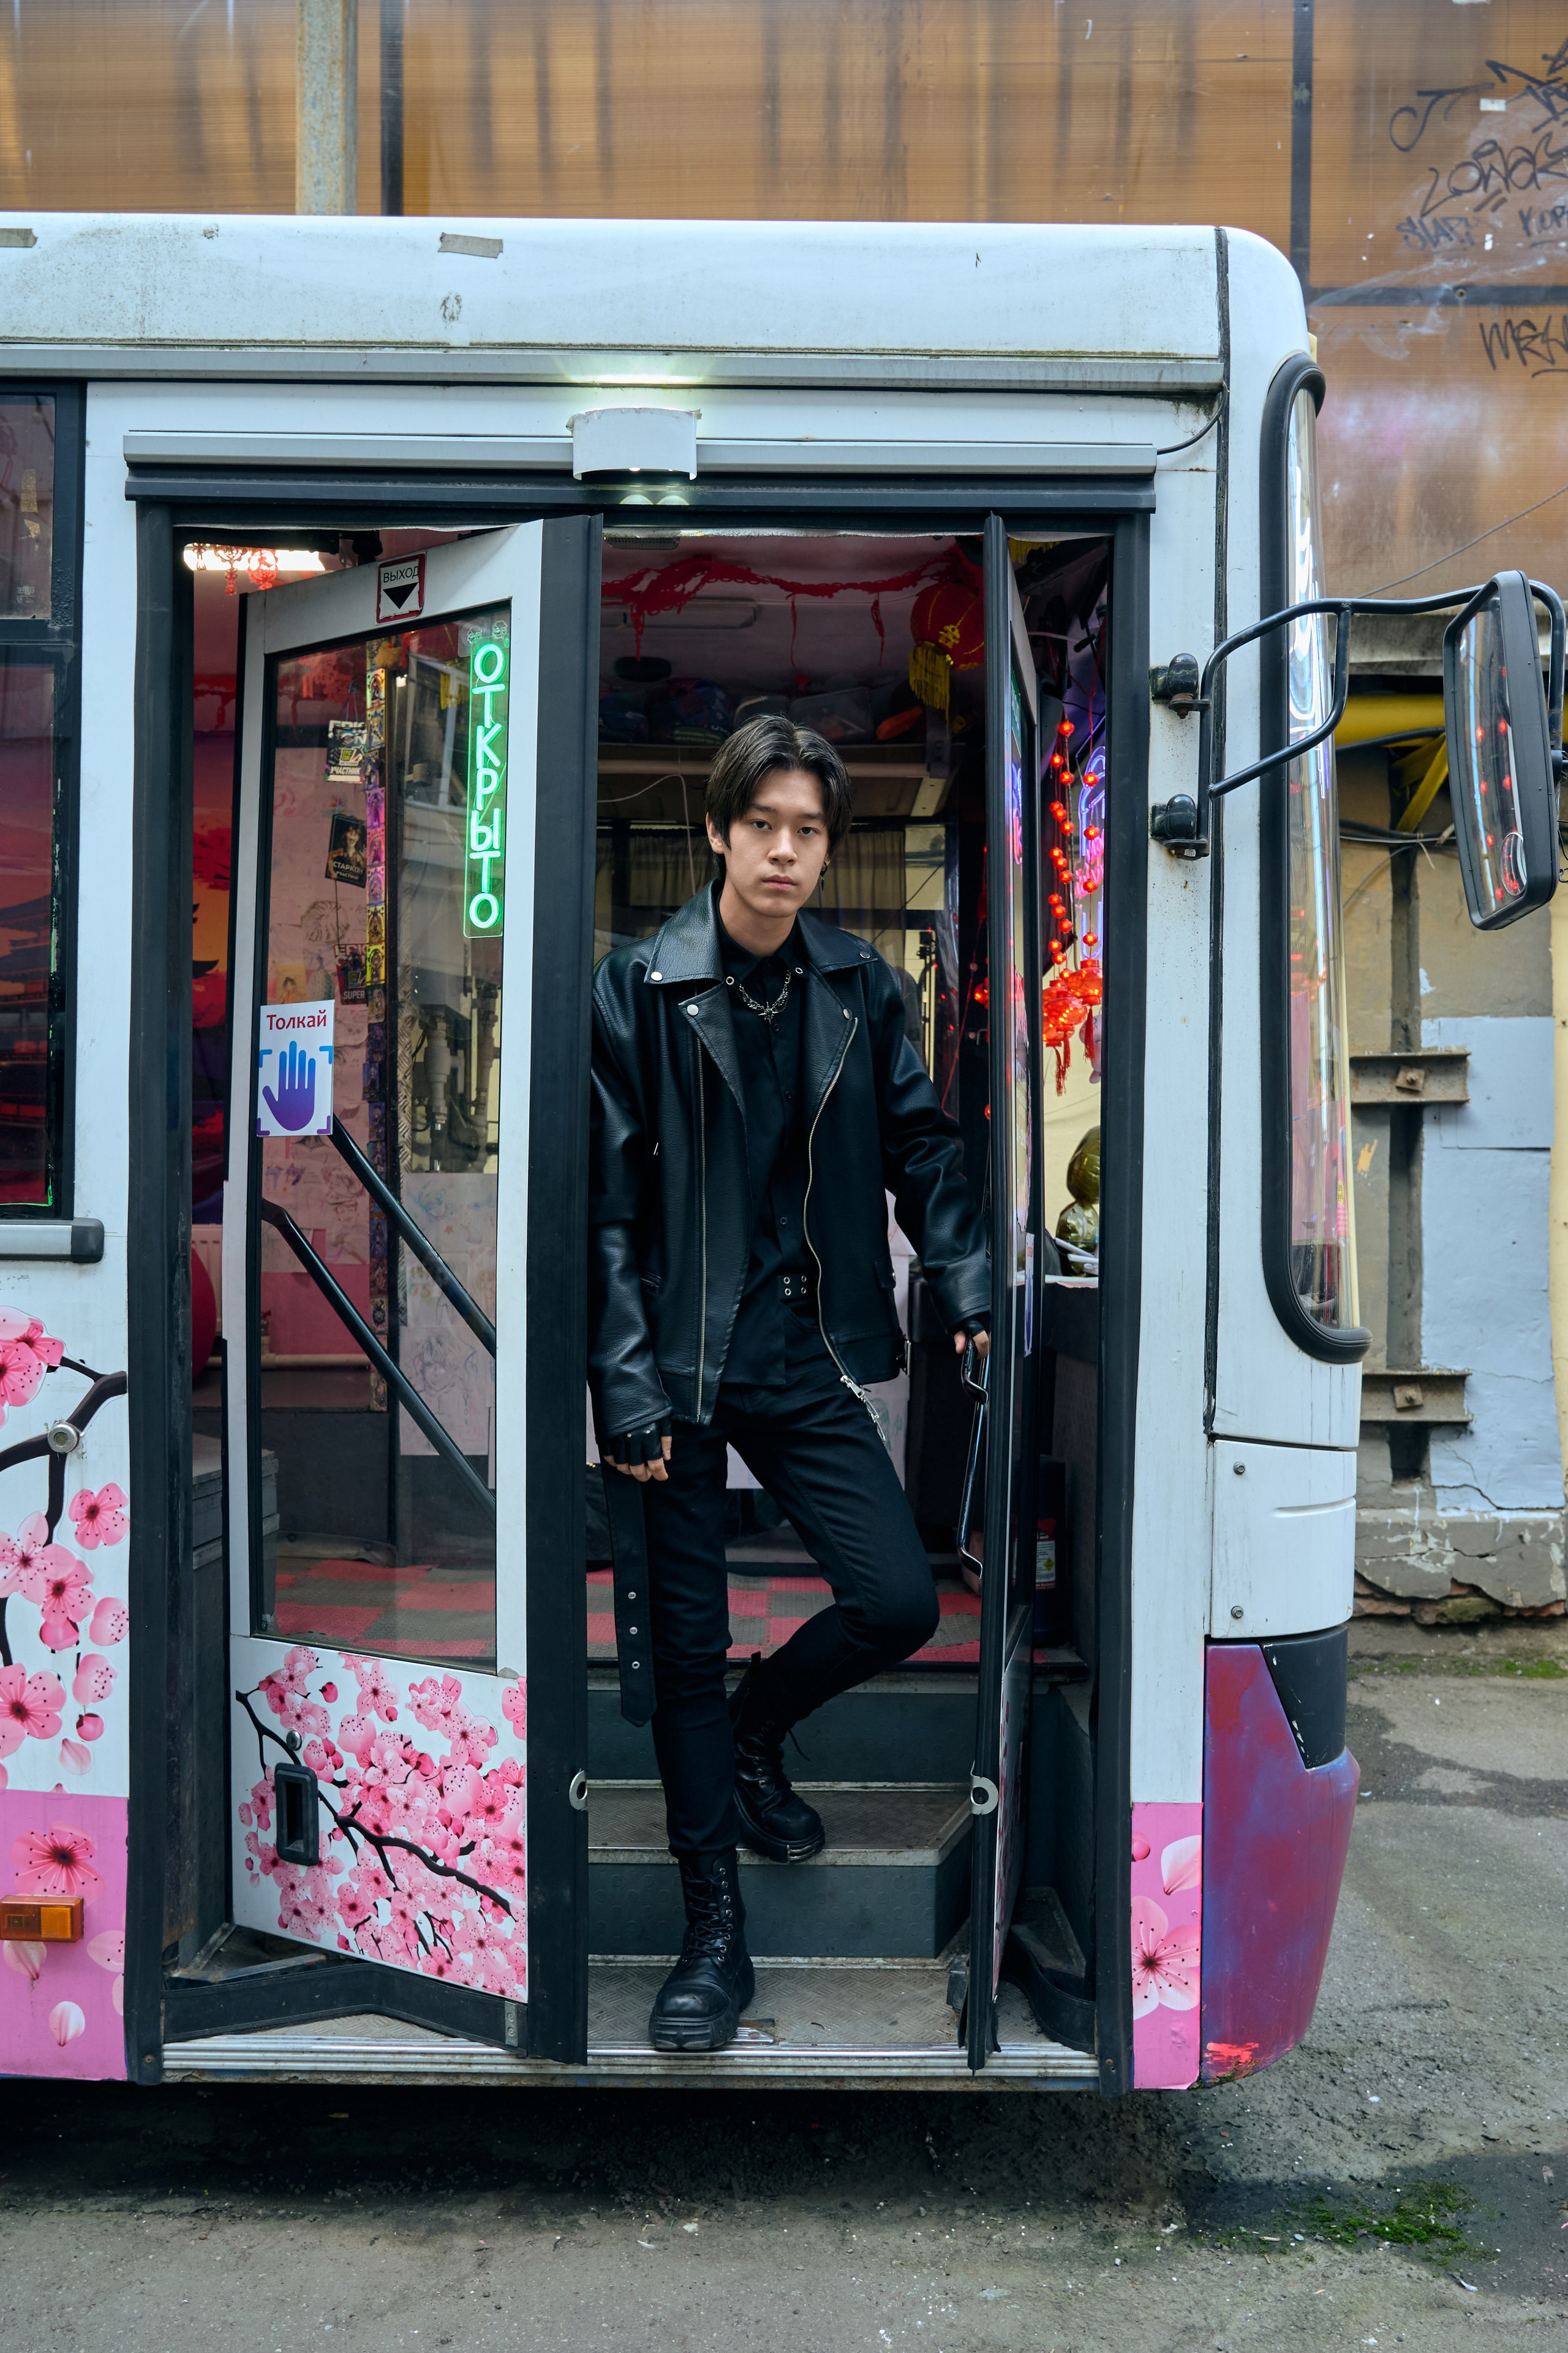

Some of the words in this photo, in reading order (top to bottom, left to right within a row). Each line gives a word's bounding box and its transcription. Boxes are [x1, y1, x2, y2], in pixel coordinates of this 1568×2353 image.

[383, 567, 419, 583] ВЫХОД
[330, 766, 361, 776] УЧАСТНИК
[469, 643, 506, 929] ОТКРЫТО
[344, 991, 365, 1000] SUPER
[266, 1009, 326, 1030] Толкай
